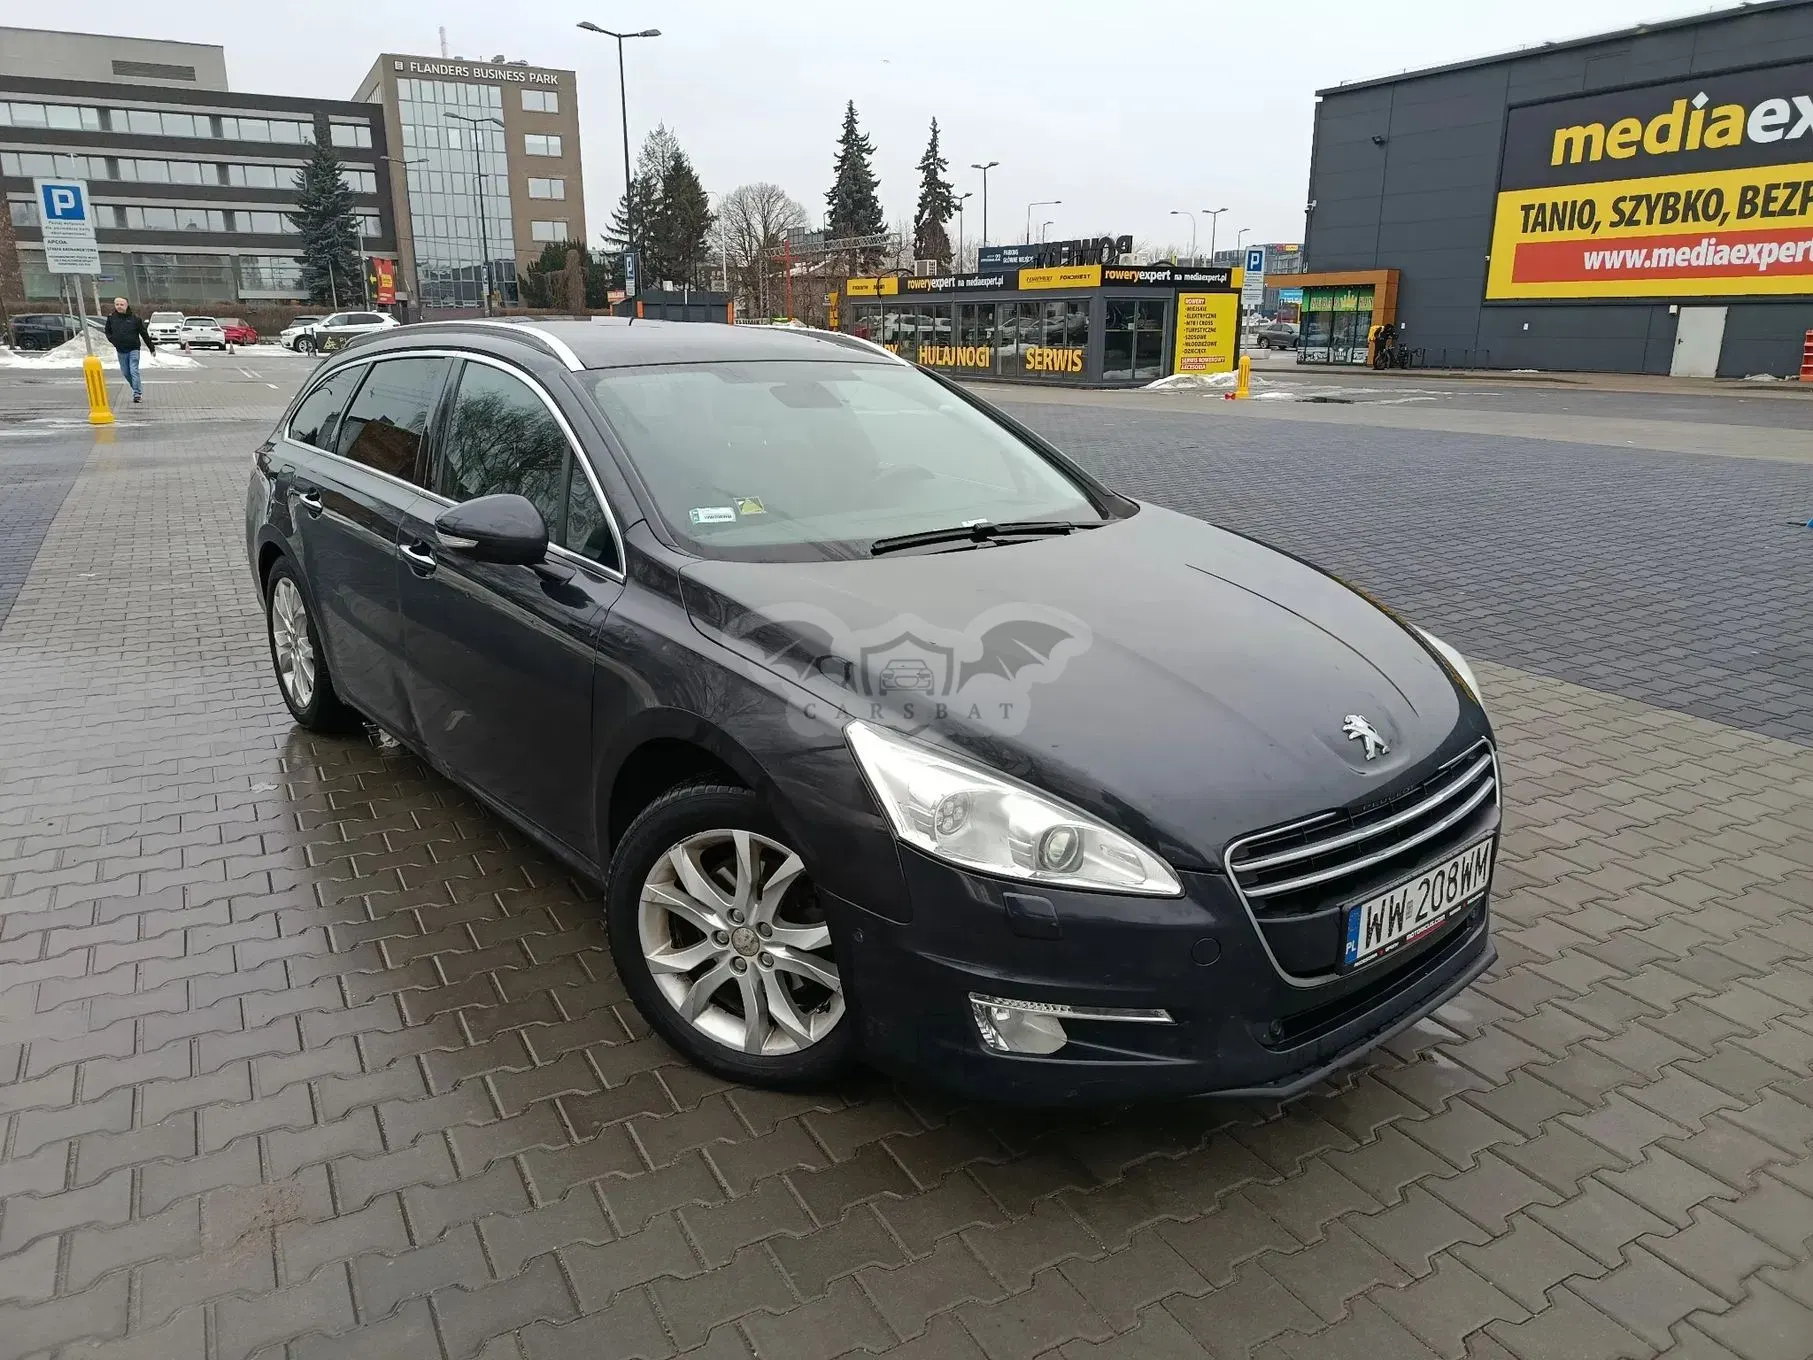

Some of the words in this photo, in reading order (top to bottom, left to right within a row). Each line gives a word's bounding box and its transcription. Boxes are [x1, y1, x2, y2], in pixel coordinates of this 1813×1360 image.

[410, 62, 469, 77] FLANDERS
[473, 67, 526, 82] BUSINESS
[529, 72, 559, 85] PARK
[51, 188, 75, 216] P
[1520, 198, 1601, 235] TANIO,
[1609, 187, 1731, 227] SZYBKO,
[1250, 252, 1260, 270] P
[907, 276, 955, 292] roweryexpert
[965, 275, 1004, 288] mediaexpert.pl
[1105, 269, 1171, 283] roweryexpert
[1184, 272, 1227, 282] mediaexpert.pl
[918, 345, 991, 368] HULAJNOGI
[1025, 347, 1083, 372] SERWIS
[1365, 888, 1408, 950] WW
[1414, 842, 1490, 924] 208WM
[1345, 940, 1357, 955] PL
